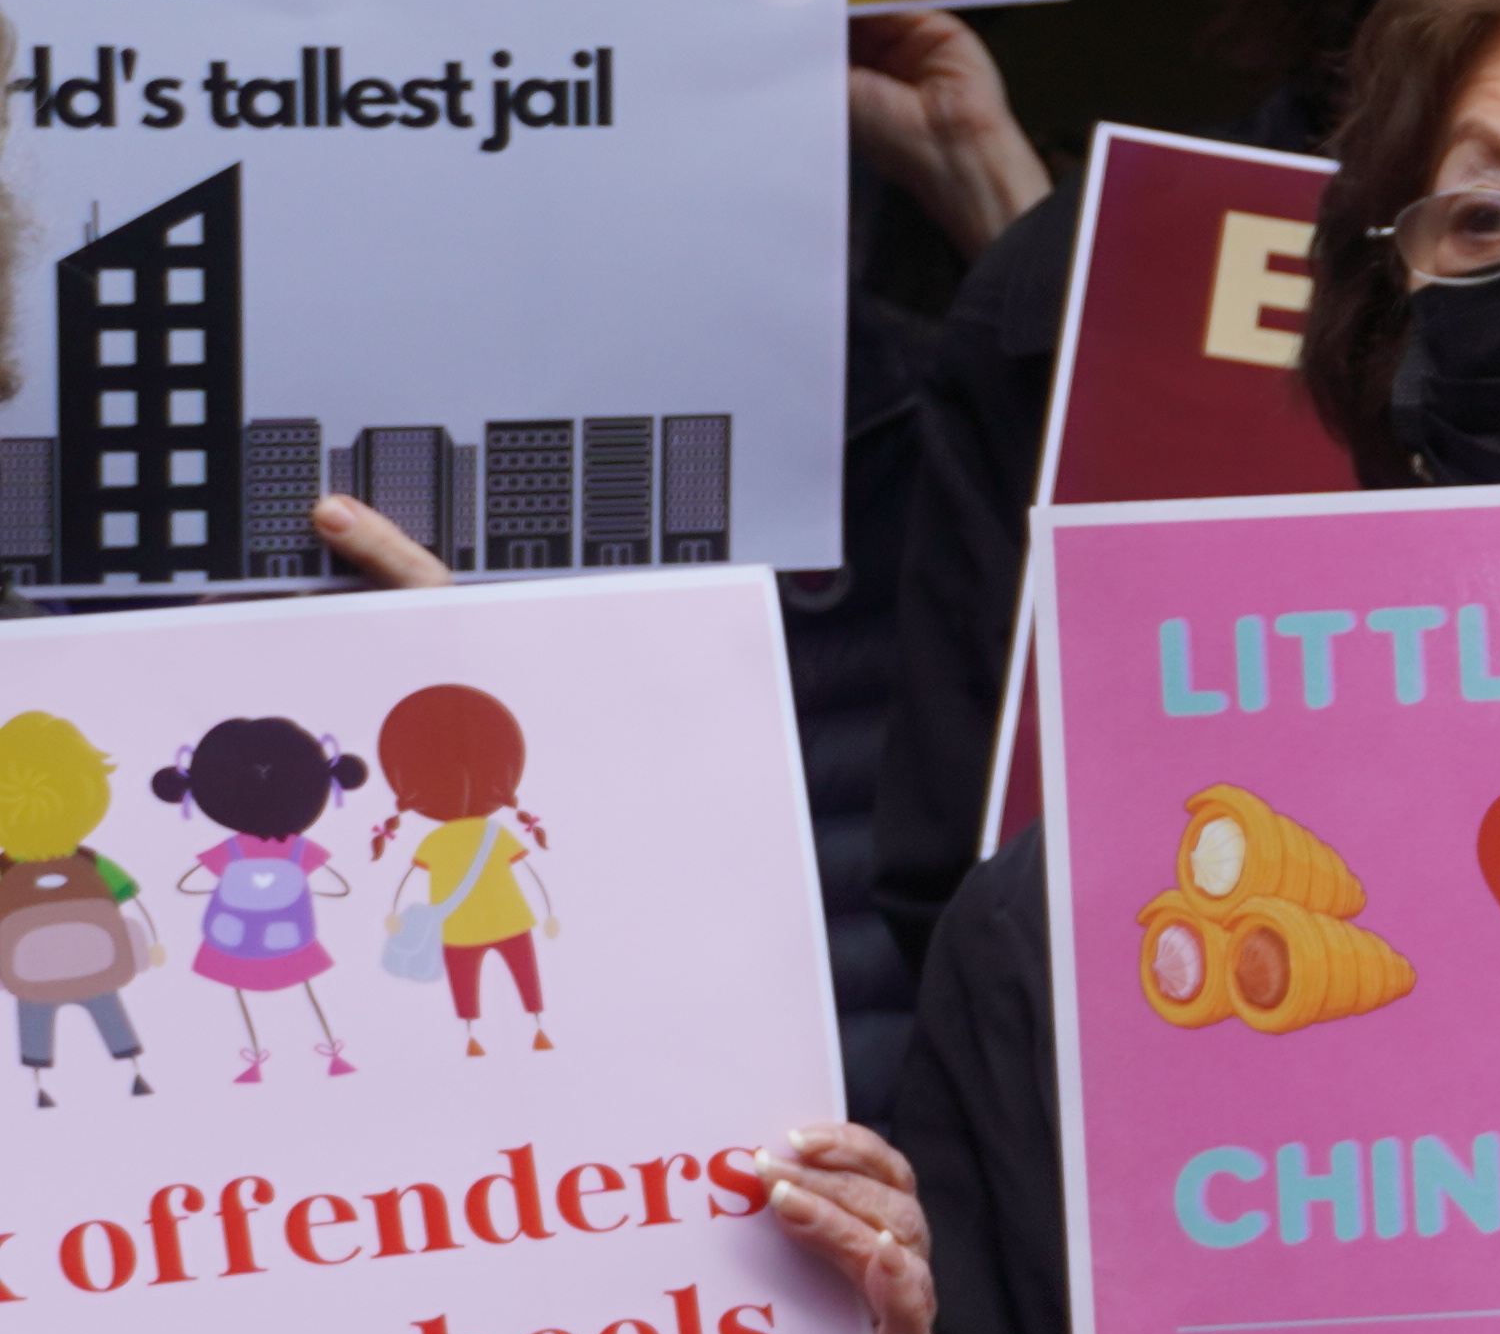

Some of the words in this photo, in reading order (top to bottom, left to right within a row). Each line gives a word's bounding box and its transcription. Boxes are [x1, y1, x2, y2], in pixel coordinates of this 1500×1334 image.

[203, 47, 475, 131] tallest
[478, 47, 614, 154] jail
[58, 1140, 772, 1295] offenders
